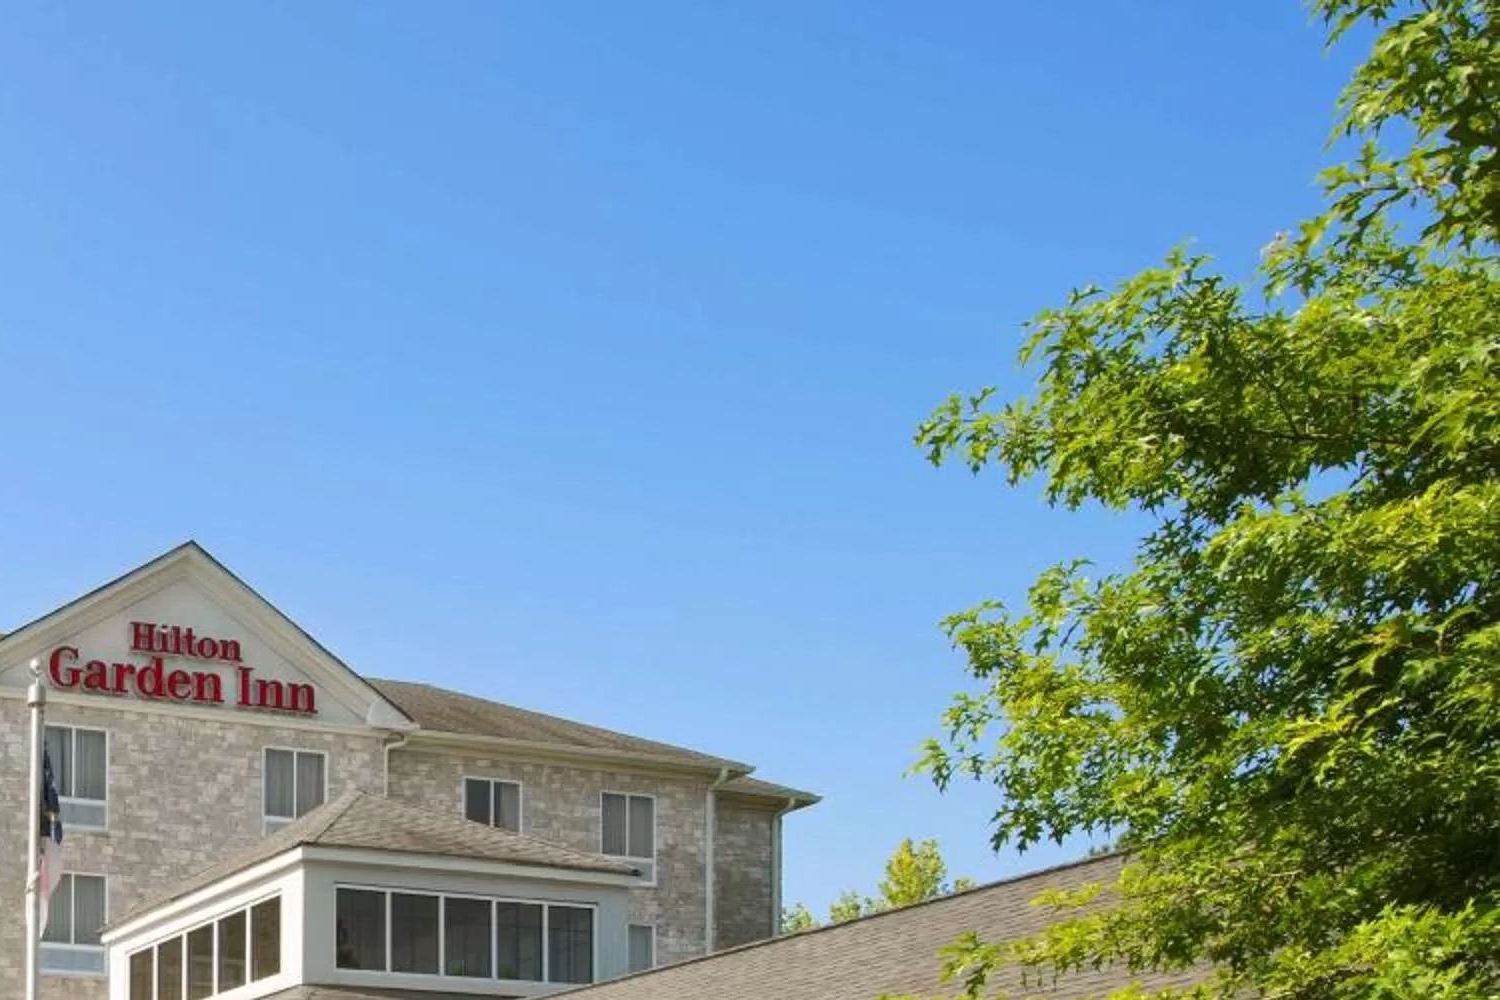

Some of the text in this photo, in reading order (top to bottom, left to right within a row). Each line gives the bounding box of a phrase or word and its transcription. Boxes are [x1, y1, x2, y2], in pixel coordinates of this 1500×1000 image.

[131, 622, 242, 662] Hilton
[49, 646, 318, 714] Garden Inn
